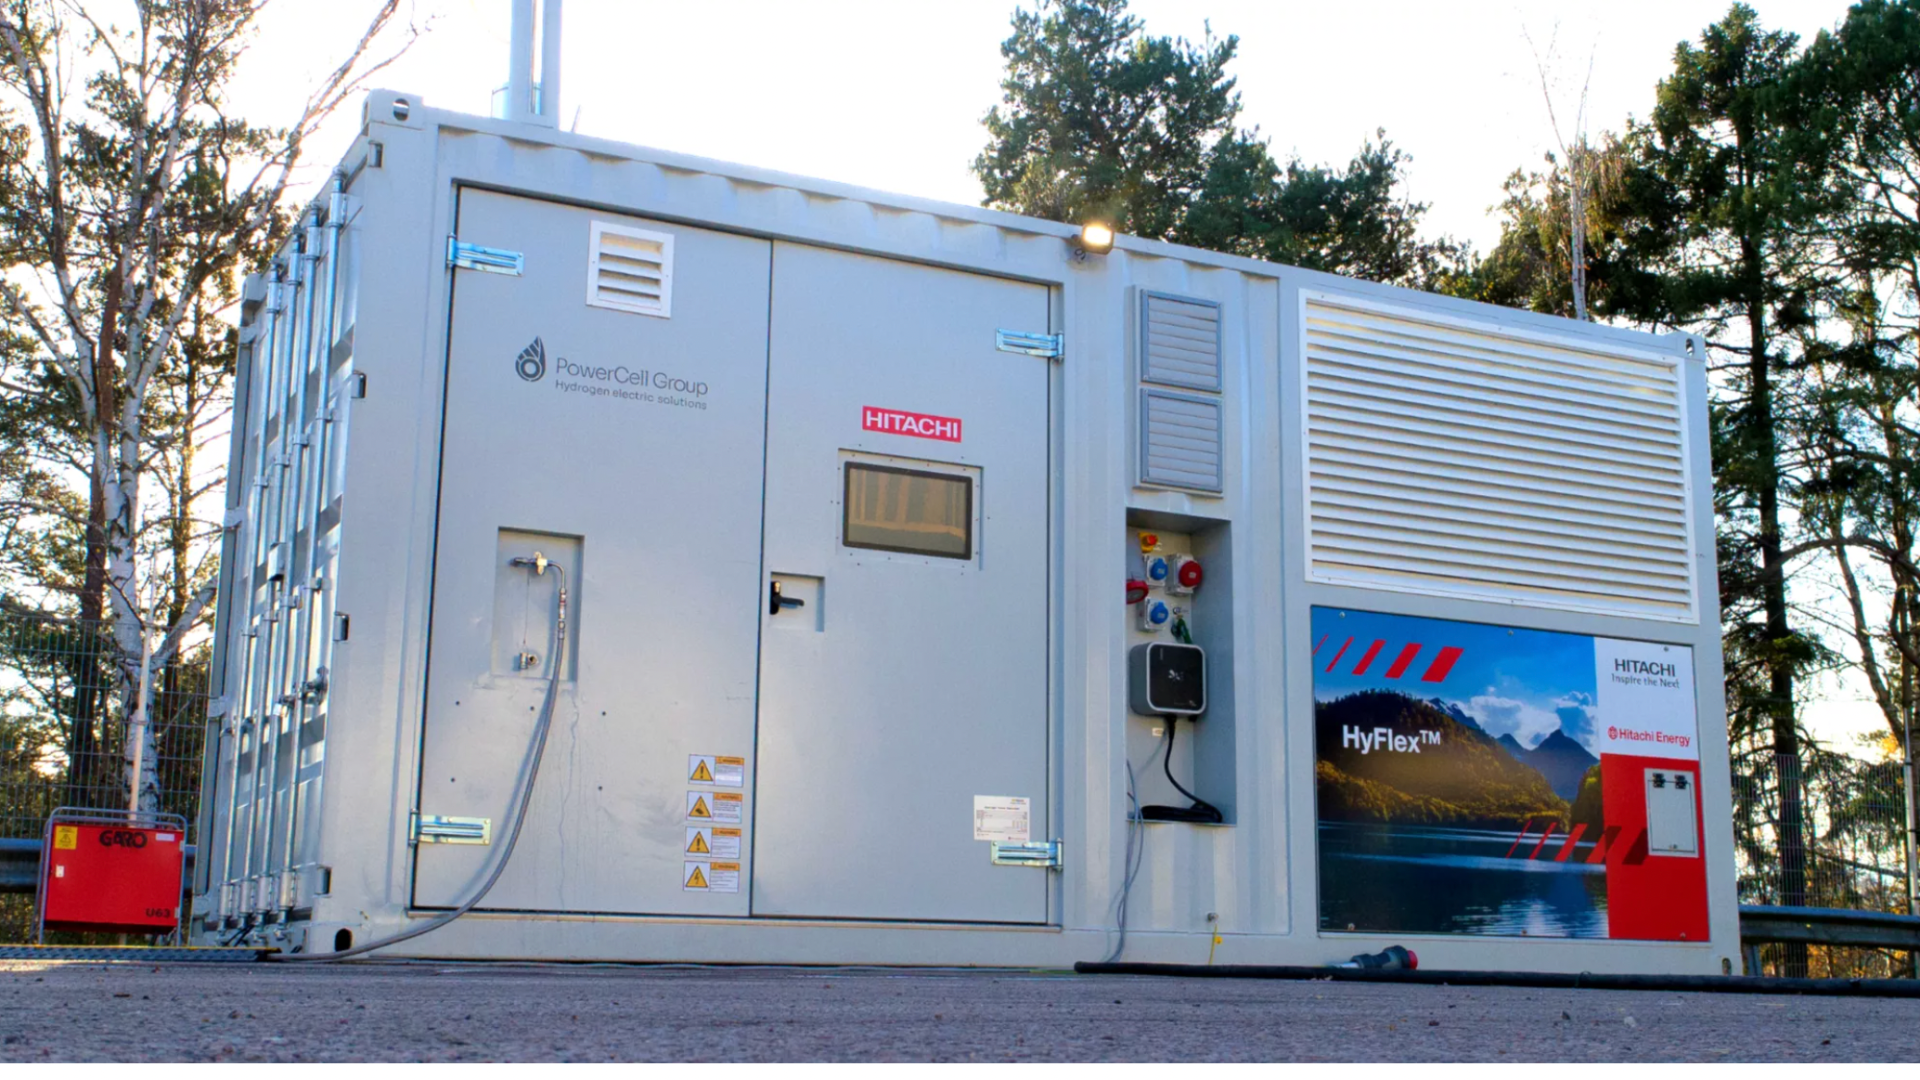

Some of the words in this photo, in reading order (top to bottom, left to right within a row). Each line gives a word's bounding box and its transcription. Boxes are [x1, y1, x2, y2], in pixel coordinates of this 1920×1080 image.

[556, 357, 649, 387] PowerCell
[653, 372, 708, 398] Group
[555, 380, 610, 397] Hydrogen
[612, 388, 654, 402] electric
[657, 394, 707, 410] solutions
[865, 409, 958, 439] HITACHI
[1614, 658, 1676, 678] HITACHI
[1611, 673, 1642, 687] Inspire
[1643, 675, 1658, 687] the
[1659, 677, 1680, 689] Next
[1618, 728, 1655, 743] Hitachi
[1656, 731, 1691, 747] Energy
[99, 829, 148, 849] GARO
[146, 908, 171, 918] U63
